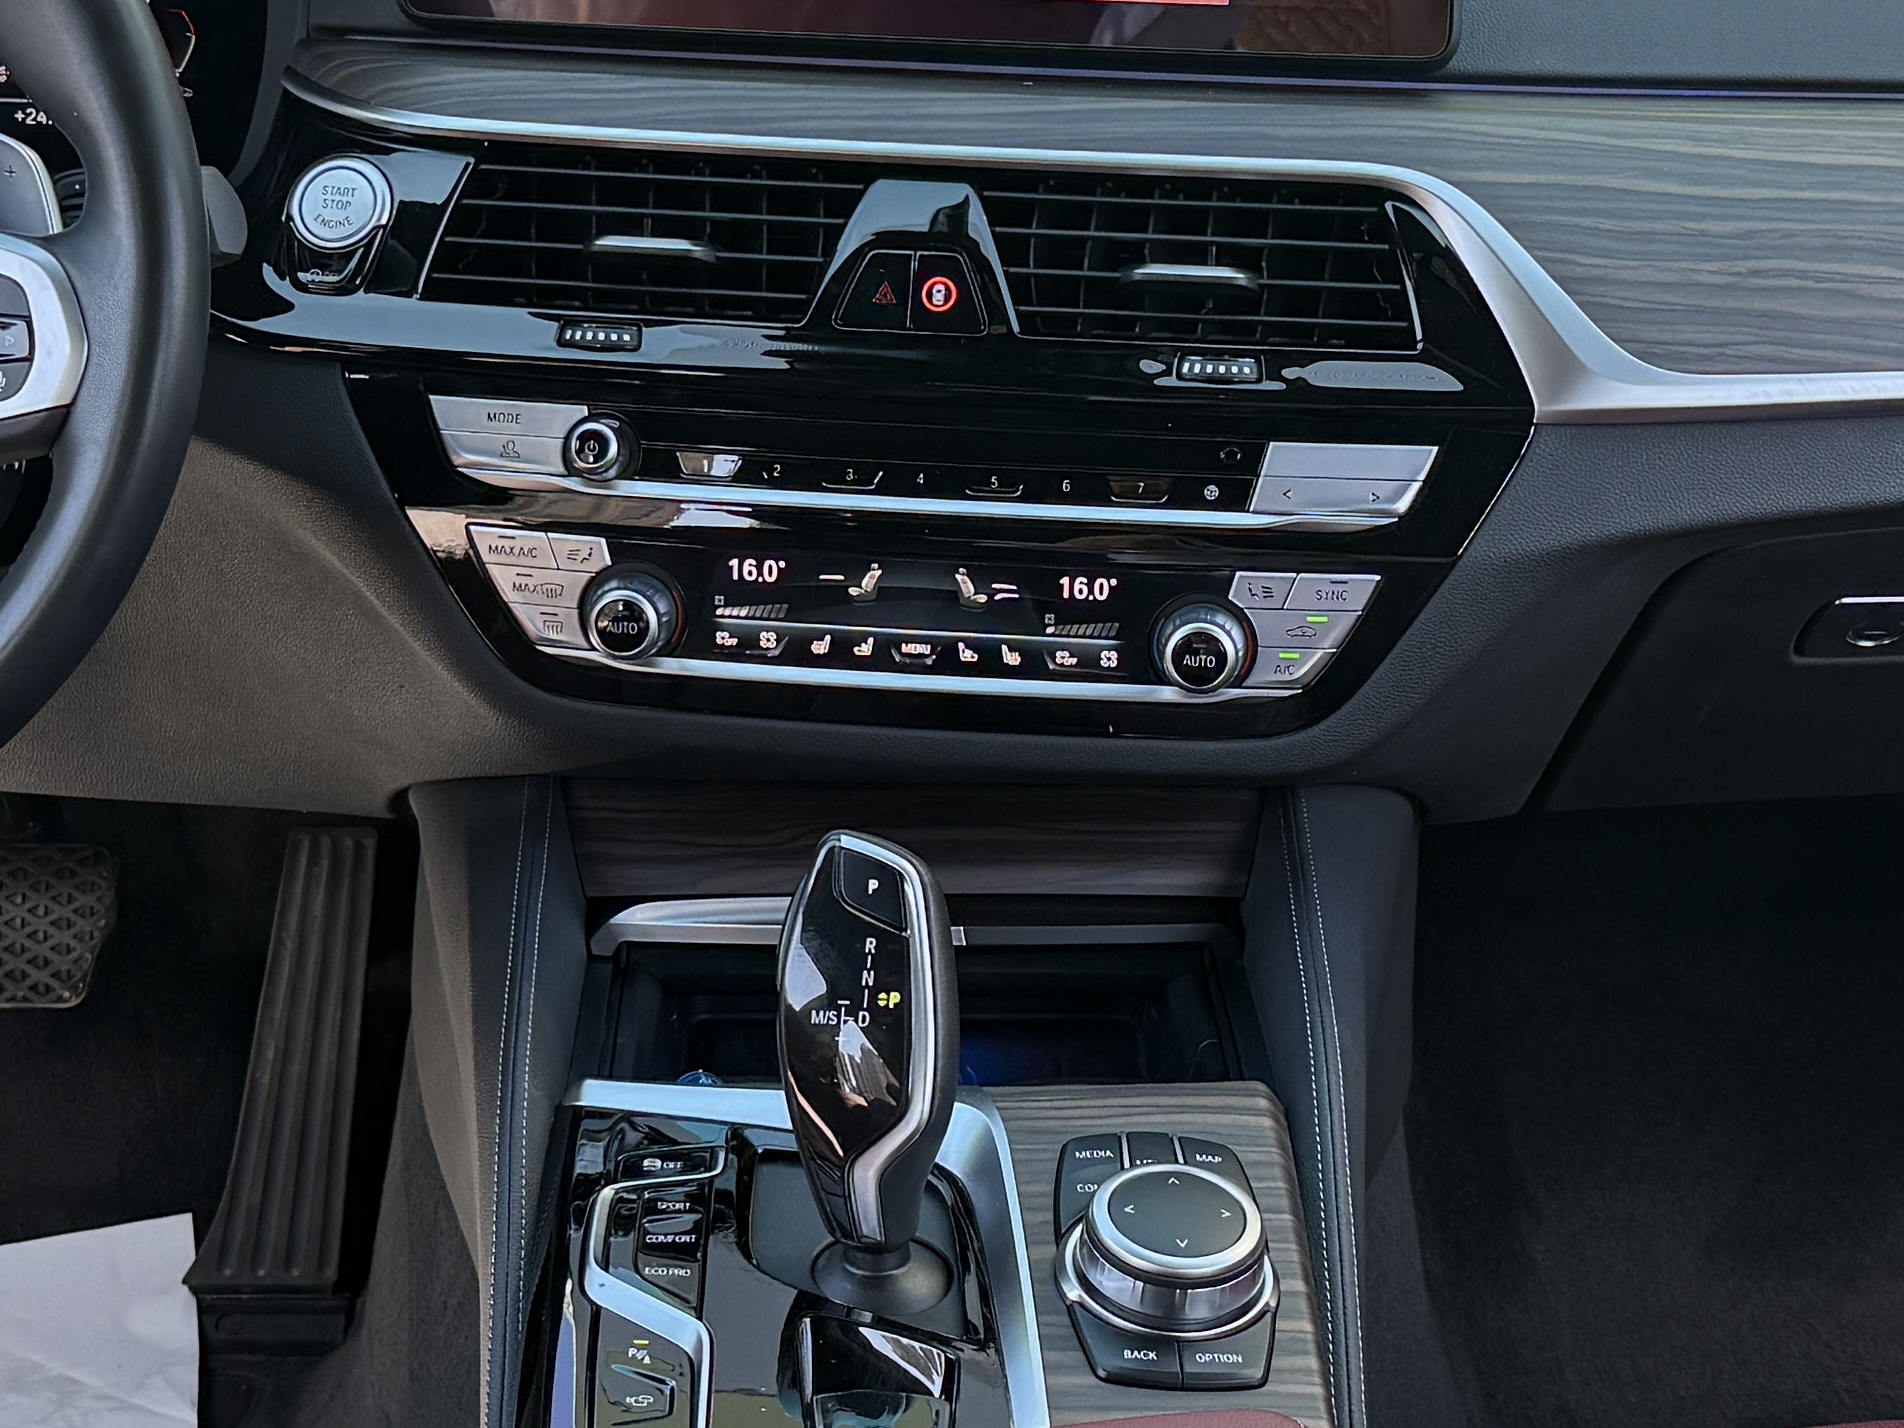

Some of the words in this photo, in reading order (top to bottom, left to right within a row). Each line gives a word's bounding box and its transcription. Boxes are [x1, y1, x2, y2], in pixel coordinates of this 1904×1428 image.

[322, 185, 358, 199] START
[322, 198, 352, 211] STOP
[314, 213, 354, 229] ENGINE
[487, 412, 522, 425] MODE
[773, 464, 781, 478] 2
[916, 473, 924, 485] 4
[990, 476, 999, 489] 5
[1062, 480, 1071, 493] 6
[1137, 482, 1145, 495] 7
[488, 543, 515, 557] MAX
[511, 581, 539, 595] MAX
[1315, 589, 1349, 603] SYNC
[606, 620, 639, 635] AUTO
[1183, 654, 1216, 669] AUTO
[1275, 664, 1295, 677] A/C
[867, 878, 879, 895] P
[864, 938, 876, 954] R
[861, 970, 874, 987] N
[888, 992, 901, 1008] P
[811, 1009, 838, 1025] M/S
[858, 1011, 870, 1027] D
[1075, 1149, 1114, 1159] MEDIA
[1196, 1153, 1223, 1164] MAP
[663, 1160, 685, 1170] OFF
[657, 1201, 691, 1211] SPORT
[645, 1233, 696, 1244] COMFORT
[645, 1267, 667, 1276] ECO
[1123, 1349, 1157, 1361] BACK
[1196, 1352, 1243, 1364] OPTION
